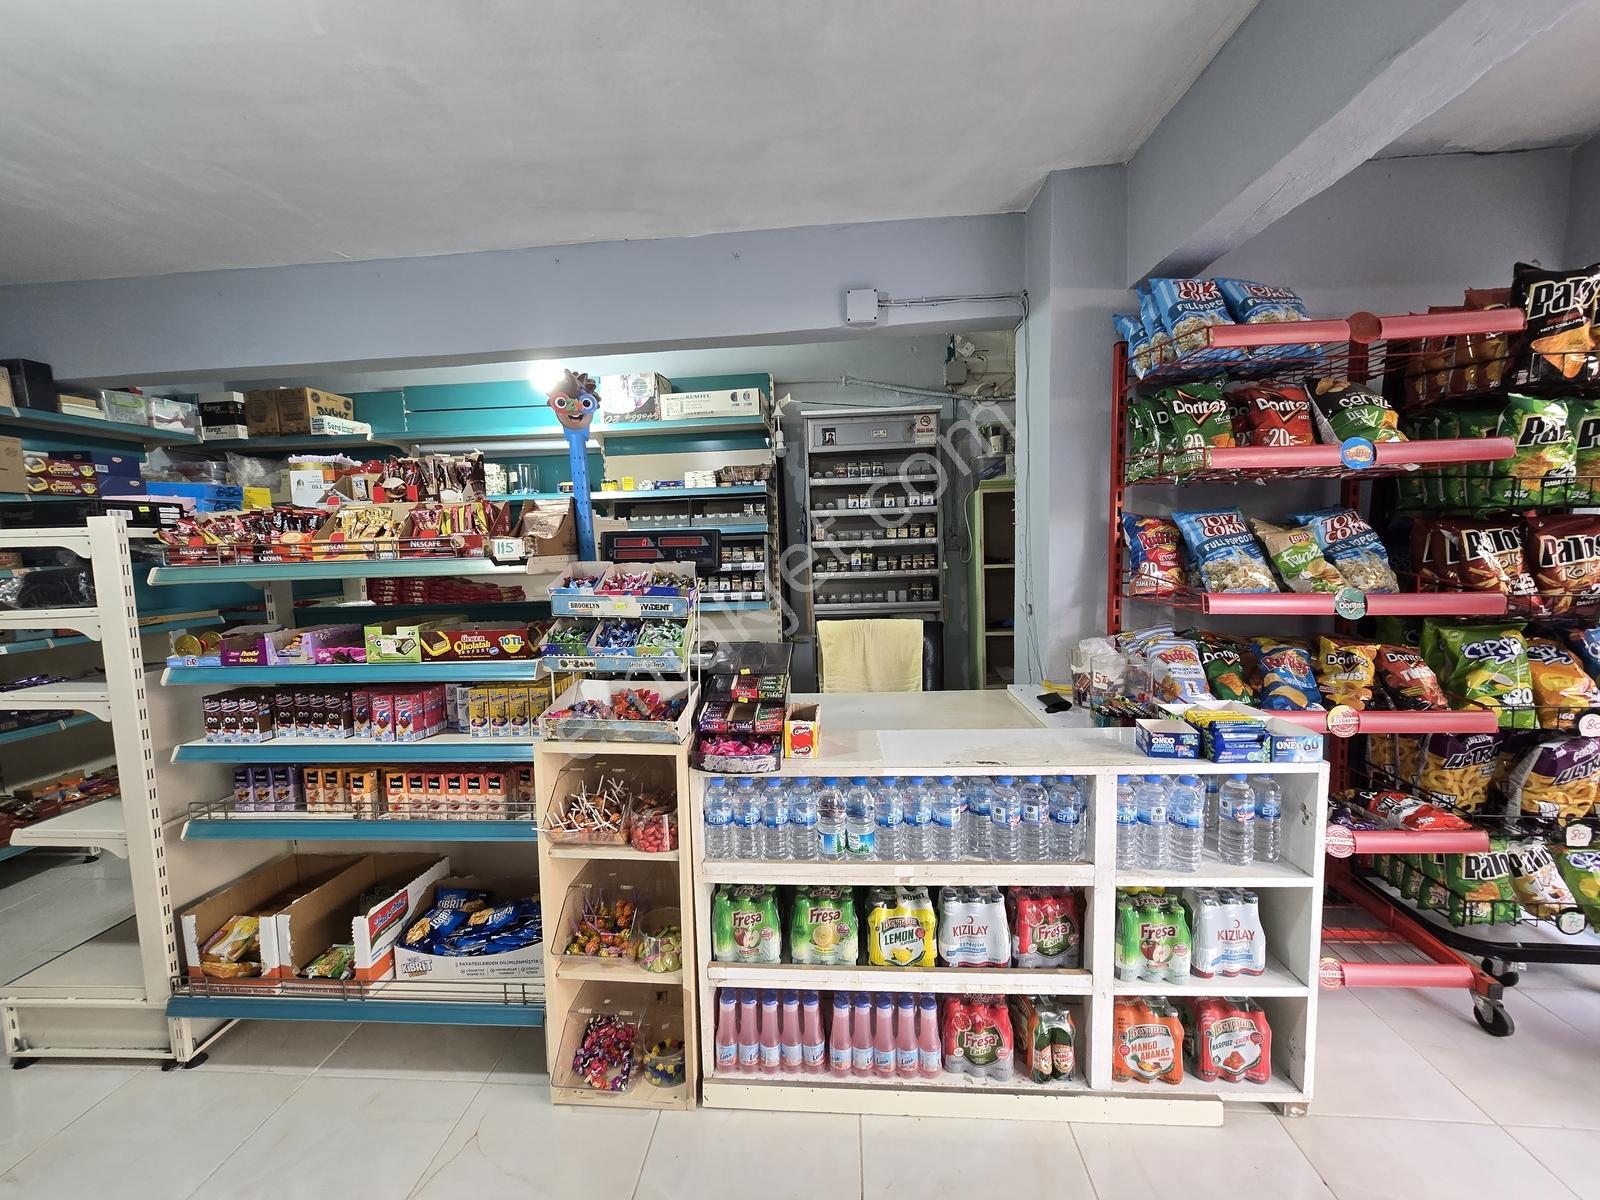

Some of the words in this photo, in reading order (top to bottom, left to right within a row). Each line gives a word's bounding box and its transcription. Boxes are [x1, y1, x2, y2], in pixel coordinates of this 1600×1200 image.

[1176, 302, 1199, 312] FULL
[1173, 399, 1227, 415] Doritos
[327, 422, 342, 432] Sera
[1198, 512, 1240, 527] TOPZ
[1203, 522, 1248, 538] CORN
[1324, 524, 1372, 544] CORN
[1203, 538, 1225, 552] FULL
[1350, 532, 1378, 547] POPCO
[1560, 564, 1598, 582] Rolls
[1339, 601, 1366, 610] Doritos
[500, 636, 510, 646] 10
[511, 636, 524, 646] TL
[1152, 736, 1175, 744] ONEO
[1276, 742, 1304, 750] ONEO
[1570, 828, 1587, 840] 80
[732, 911, 764, 926] Freşa
[809, 908, 843, 924] Freşa
[884, 929, 914, 946] LEMON
[952, 924, 989, 937] KIZILAY
[1037, 924, 1070, 940] Freşa
[1140, 924, 1178, 942] Freşa
[1216, 930, 1256, 941] KIZILAY
[964, 1031, 998, 1048] Freşa
[1131, 1040, 1158, 1052] MANGO
[1140, 1048, 1170, 1062] ANANAS
